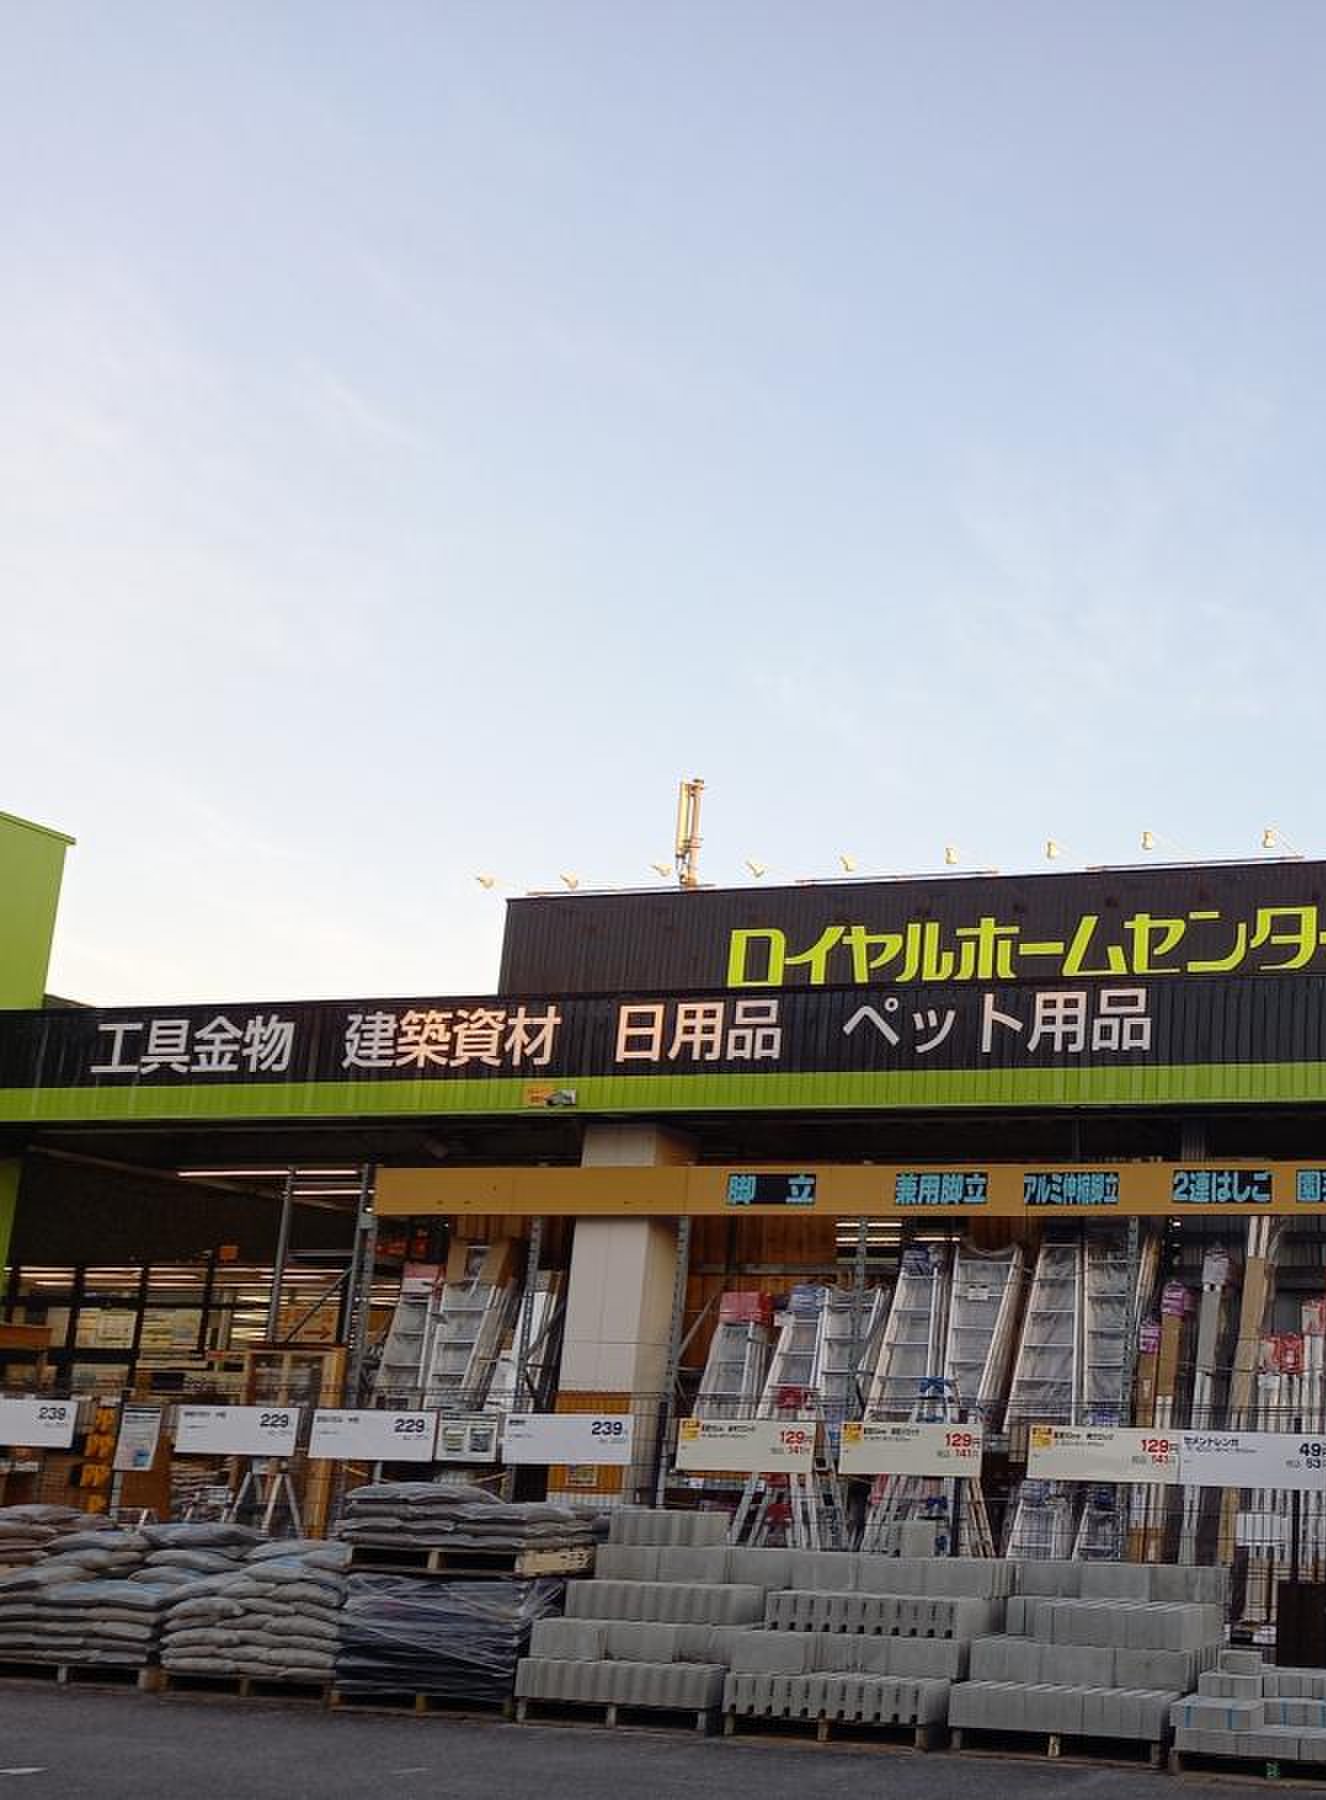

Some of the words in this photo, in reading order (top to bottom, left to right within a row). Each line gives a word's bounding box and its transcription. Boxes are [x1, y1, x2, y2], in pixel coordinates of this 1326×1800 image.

[91, 1015, 295, 1074] 工具金物
[341, 1006, 561, 1070] 建築資材
[614, 1000, 783, 1062] 日用品
[843, 988, 1152, 1055] ペット用品
[896, 1173, 988, 1204] 兼用脚立
[1173, 1170, 1272, 1202] 2連はしご
[38, 1407, 66, 1421] 239
[260, 1413, 289, 1428] 229
[395, 1418, 425, 1433] 229
[591, 1421, 623, 1436] 239
